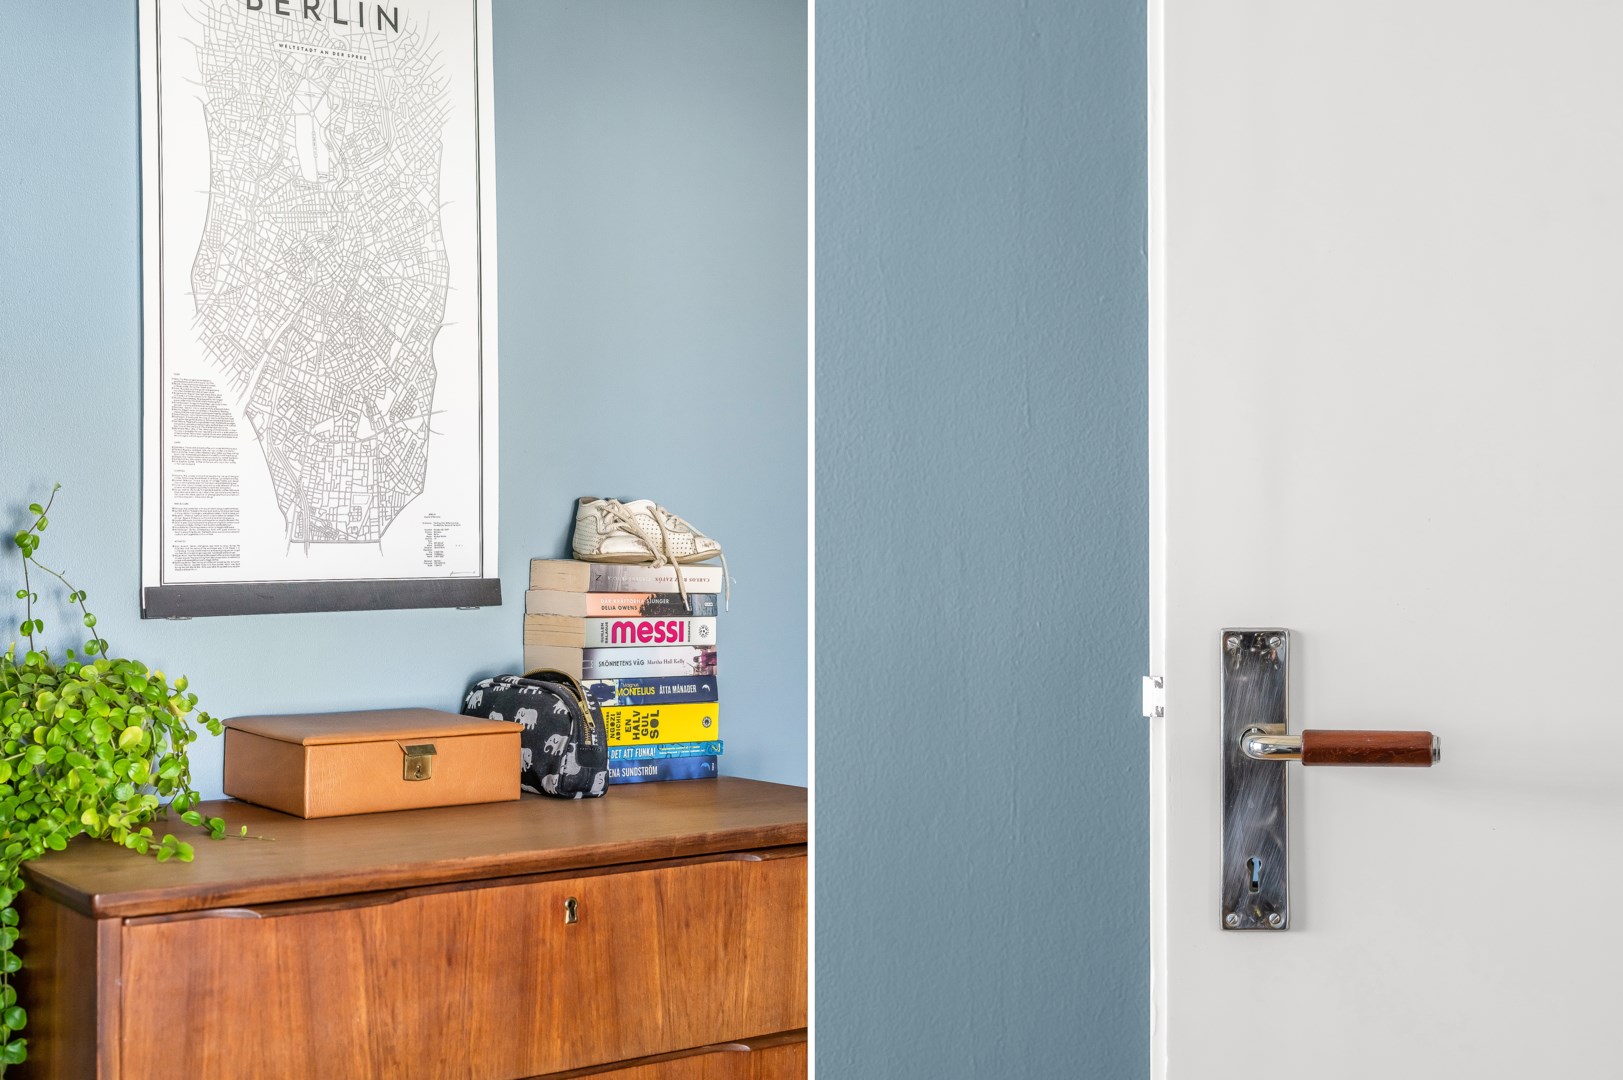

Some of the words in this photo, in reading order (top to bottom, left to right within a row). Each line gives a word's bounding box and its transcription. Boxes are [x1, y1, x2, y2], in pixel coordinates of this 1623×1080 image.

[278, 43, 317, 53] WELTSTADT
[347, 53, 367, 61] SPREE
[611, 620, 685, 644] messi
[615, 687, 656, 697] MONTELIUS
[659, 684, 672, 694] ÅTTA
[672, 684, 697, 694] MÅNADER
[625, 719, 632, 733] EN
[632, 710, 641, 741] HALV
[641, 713, 649, 736] GUL
[650, 709, 660, 739] SOL
[610, 749, 622, 759] DET
[622, 748, 634, 758] ATT
[635, 747, 656, 757] FUNKA!
[621, 765, 658, 777] SUNDSTRÖM
